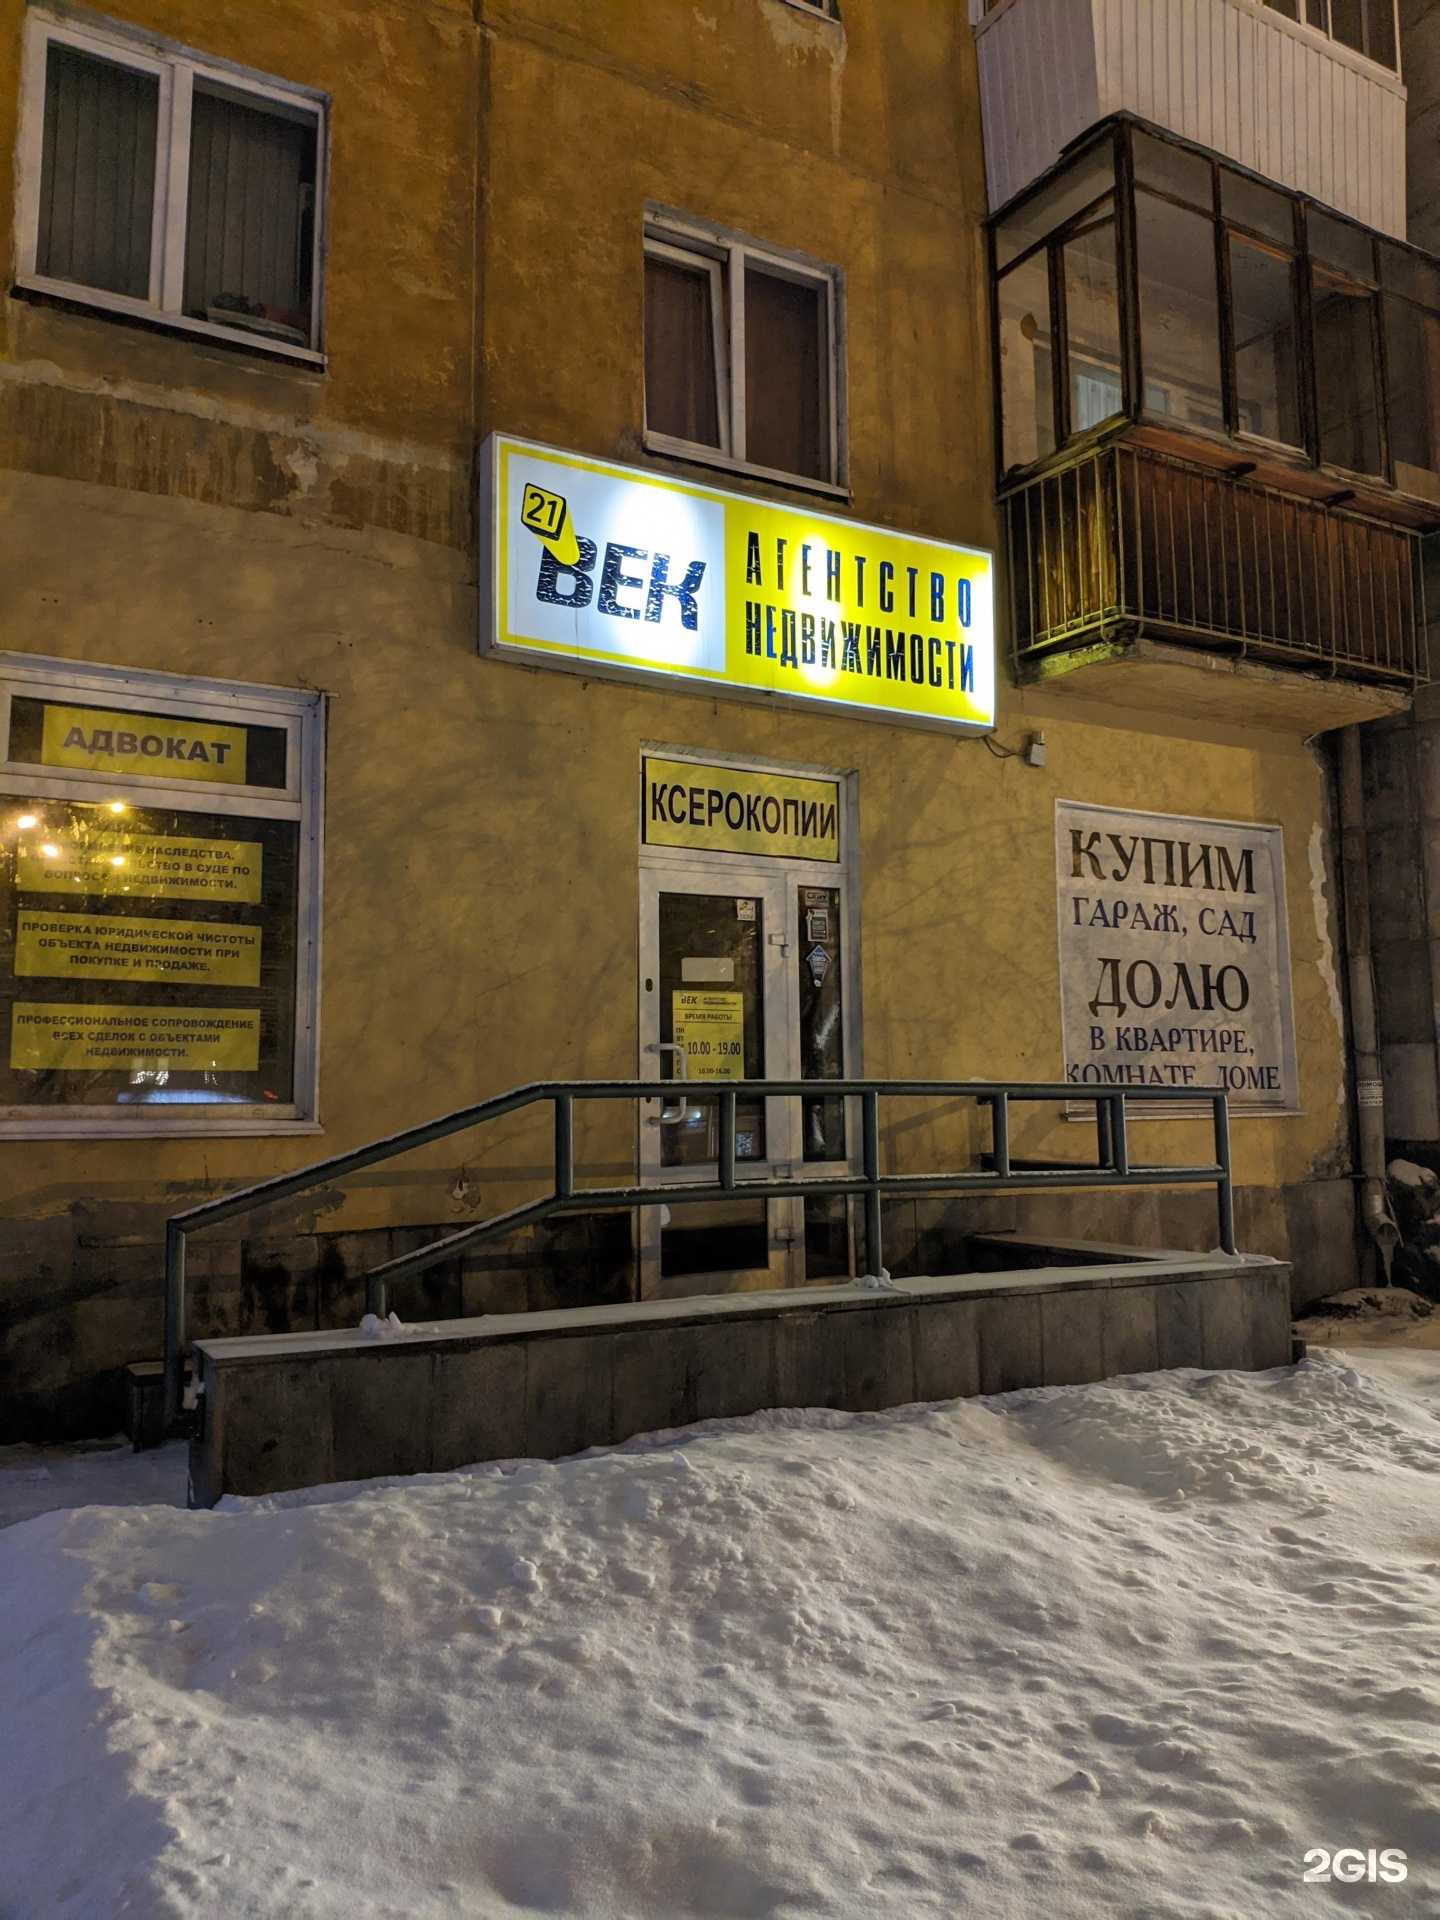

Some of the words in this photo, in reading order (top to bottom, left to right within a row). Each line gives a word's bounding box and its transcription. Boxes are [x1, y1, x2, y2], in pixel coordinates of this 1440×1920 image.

[526, 491, 559, 531] 21
[535, 535, 707, 631] ВЕК
[745, 531, 973, 628] АГЕНТСТВО
[744, 600, 975, 694] НЕДВИЖИМОСТИ
[63, 726, 232, 765] АДВОКАТ
[651, 782, 836, 841] КСЕРОКОПИИ
[184, 862, 193, 872] В
[196, 863, 230, 875] СУДЕ
[232, 865, 251, 876] ПО
[1068, 828, 1258, 894] КУПИМ
[21, 921, 92, 936] ПРОВЕРКА
[95, 926, 193, 941] ЮРИДИЧЕСКОЙ
[197, 932, 256, 946] ЧИСТОТЫ
[1072, 896, 1189, 937] ГАРАЖ,
[1198, 907, 1258, 944] САД
[39, 938, 101, 951] ОБЪЕКТА
[104, 942, 212, 957] НЕДВИЖИМОСТИ
[216, 948, 240, 959] ПРИ
[70, 955, 129, 967] ПОКУПКЕ
[133, 958, 141, 968] И
[145, 959, 211, 972] ПРОДАЖЕ.
[1088, 957, 1250, 1018] ДОЛЮ
[16, 1014, 149, 1028] ПРОФЕССИОНАЛЬНОЕ
[151, 1017, 254, 1030] СОПРОВОЖДЕНИЕ
[87, 1031, 135, 1042] СДЕЛОК
[139, 1033, 146, 1042] С
[150, 1033, 221, 1043] ОБЪЕКТАМИ
[85, 1047, 189, 1058] НЕДВИЖИМОСТИ.
[688, 1041, 711, 1055] 10.00
[718, 1042, 741, 1056] 19.00
[1089, 1025, 1105, 1051] В
[1115, 1026, 1255, 1057] КВАРТИРЕ,
